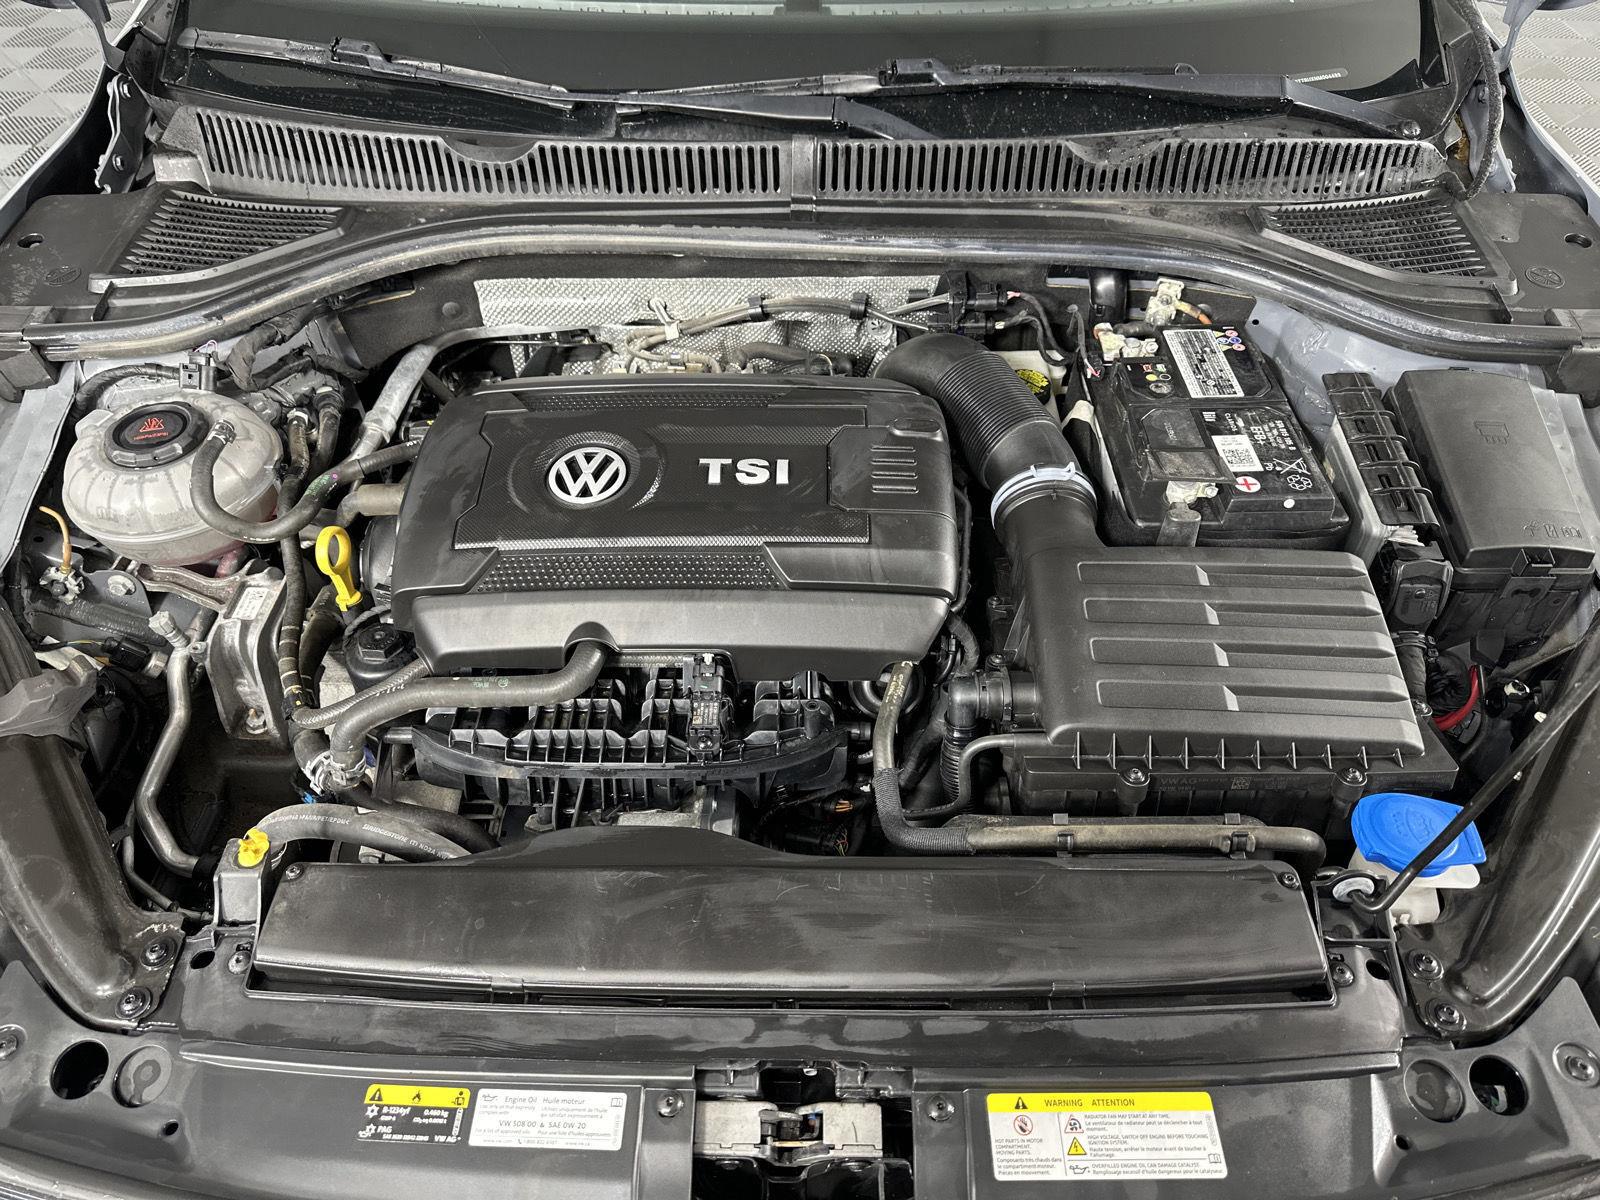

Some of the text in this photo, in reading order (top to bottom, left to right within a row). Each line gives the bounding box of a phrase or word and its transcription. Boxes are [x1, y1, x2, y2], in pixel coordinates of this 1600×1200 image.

[698, 458, 790, 485] TSI
[504, 1096, 527, 1104] Engine
[542, 1096, 559, 1104] Huile
[560, 1097, 586, 1105] moteur
[1044, 1099, 1135, 1107] WARNING ATTENTION
[382, 1107, 412, 1116] R-1234yf
[548, 1121, 561, 1129] SAE
